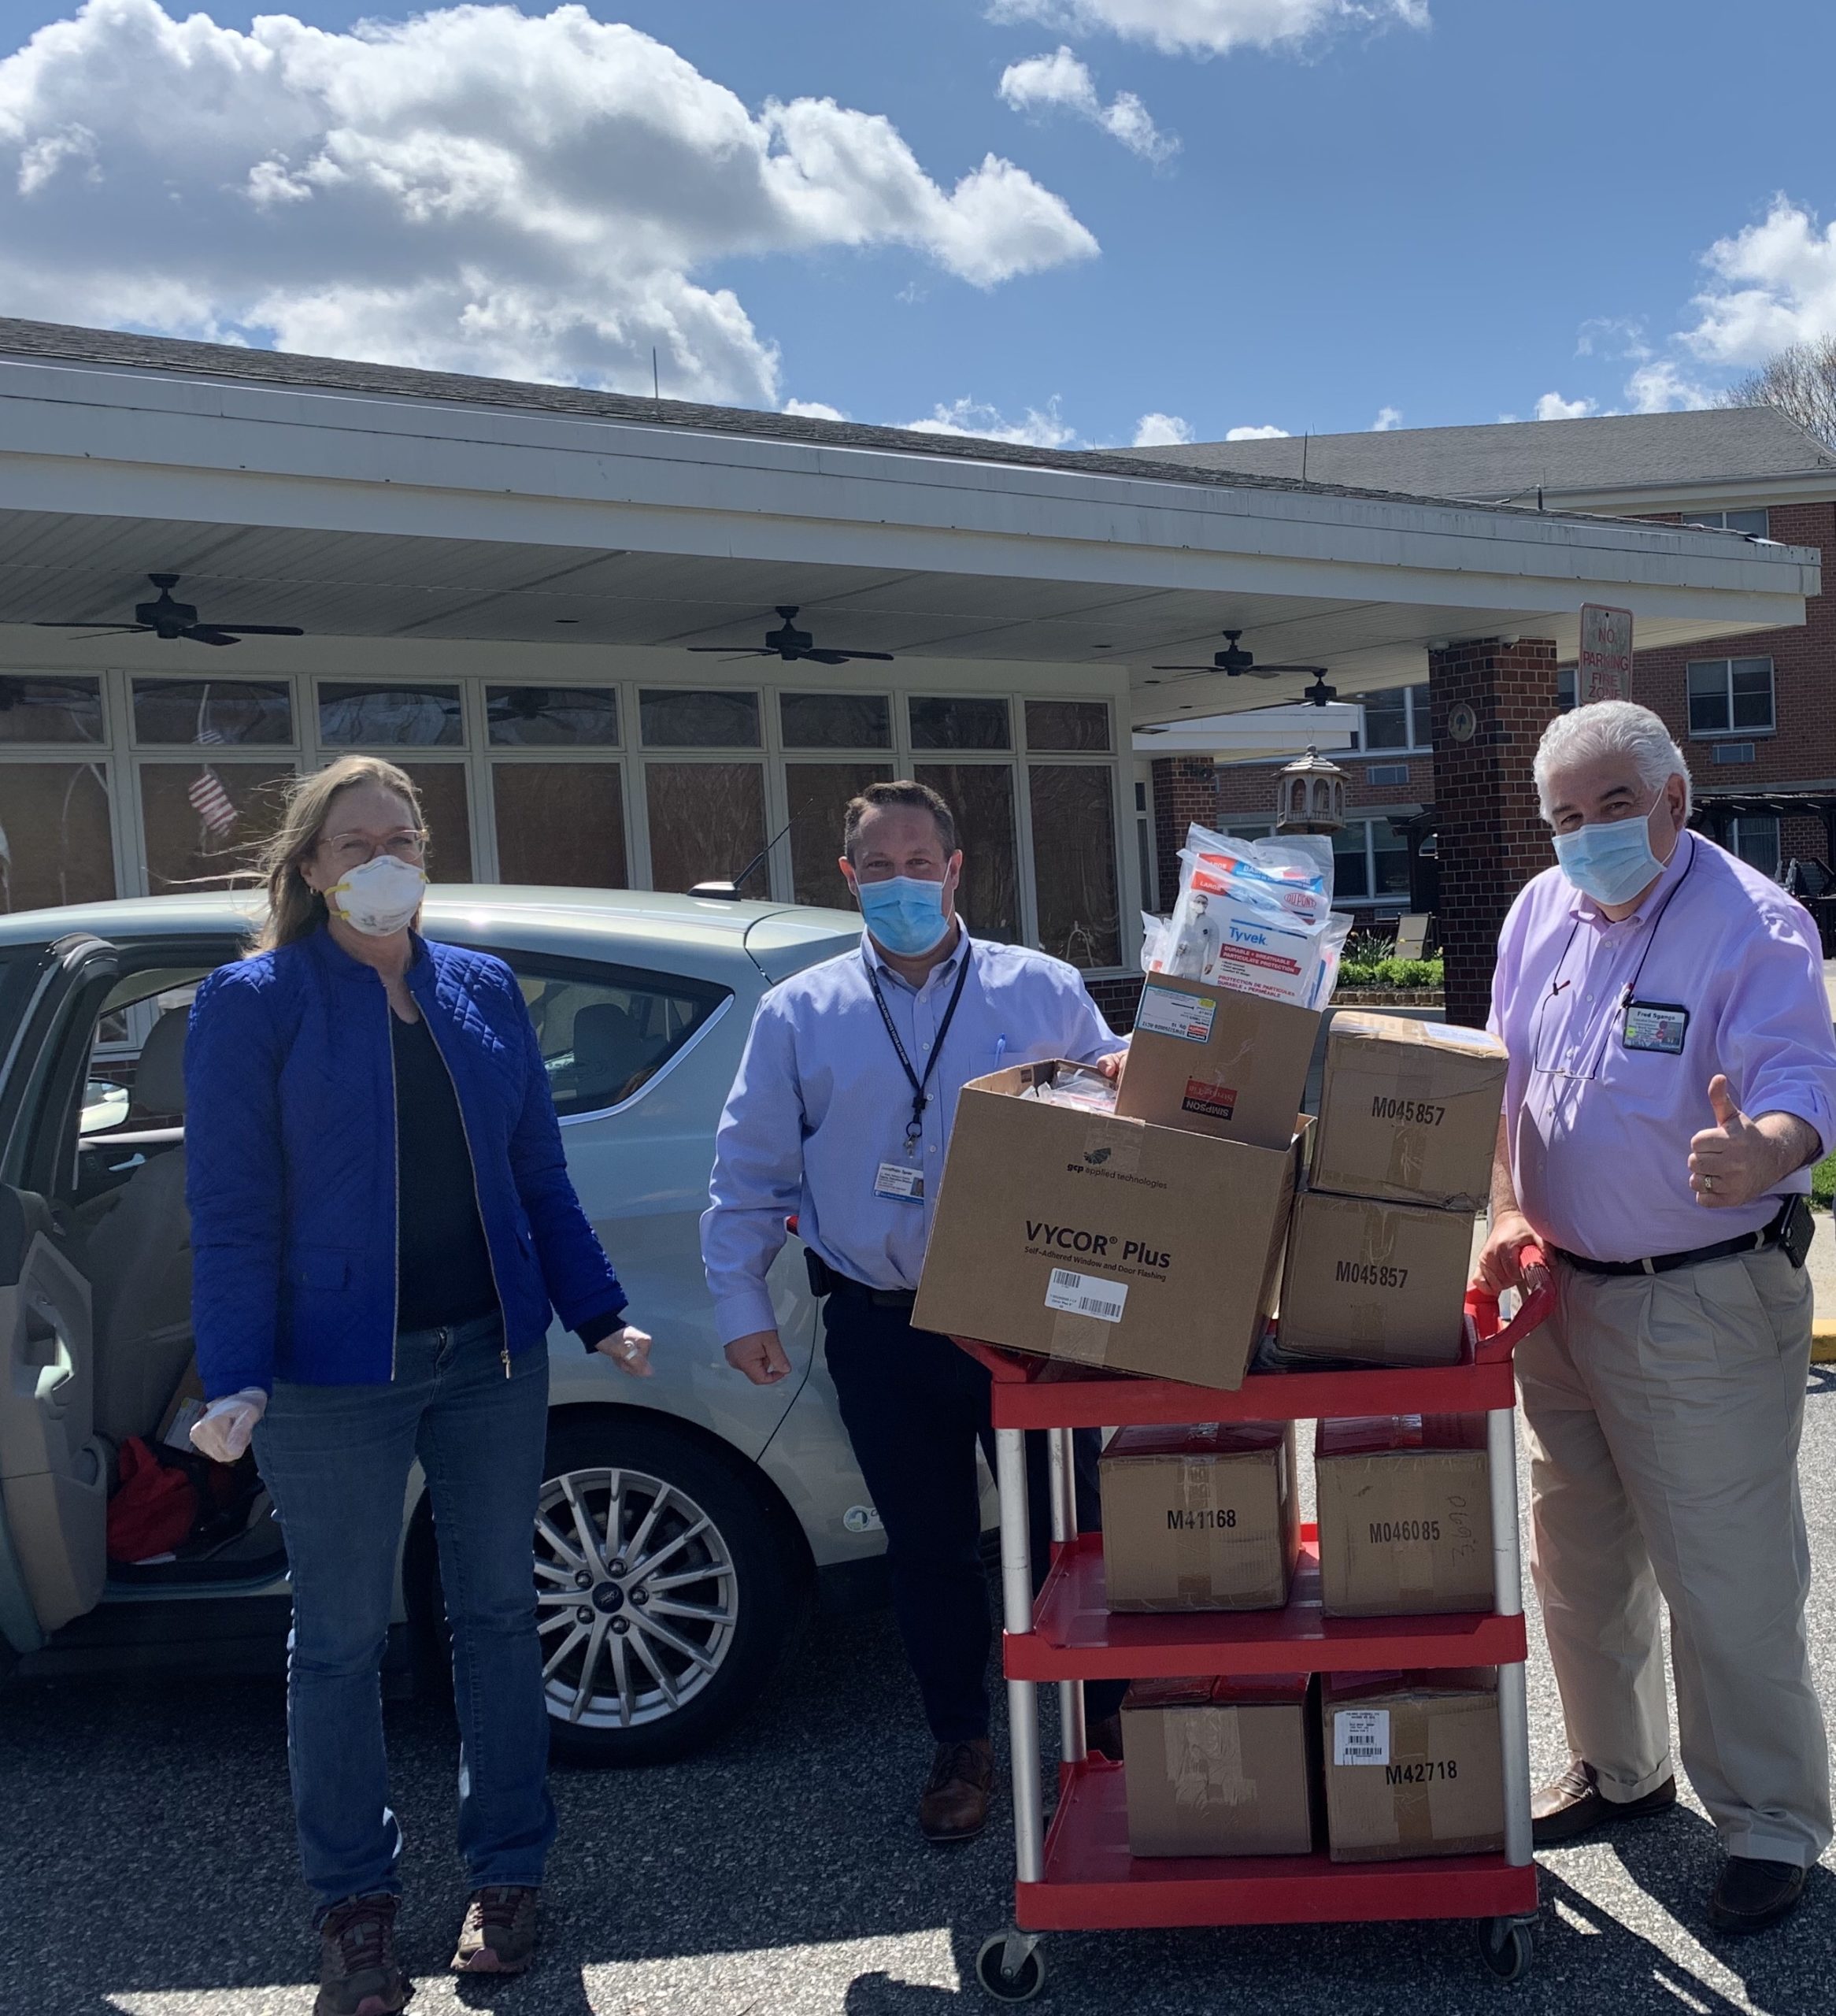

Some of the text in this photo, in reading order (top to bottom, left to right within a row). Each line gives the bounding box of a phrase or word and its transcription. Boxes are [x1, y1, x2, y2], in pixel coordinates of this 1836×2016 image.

[1598, 628, 1614, 643] NO
[1582, 650, 1629, 671] PARKING
[1592, 672, 1618, 687] FIRE
[1223, 945, 1291, 965] DURABLE BREATHABLE
[1223, 952, 1295, 973] PARTICULATE PROTECTION
[1217, 980, 1242, 989] DURABLE
[1218, 975, 1253, 987] PROTECTION
[1186, 1100, 1230, 1117] SIMPSON
[1371, 1096, 1445, 1126] M045857
[1067, 1164, 1168, 1189] gcp applied technologies
[1024, 1246, 1167, 1282] Self-Adhered Window and Door Flashing
[1123, 1240, 1171, 1268] Plus
[1335, 1261, 1408, 1288] M045857
[1167, 1509, 1237, 1530] M41168
[1369, 1521, 1441, 1544] M046085
[1386, 1760, 1458, 1786] M42718
